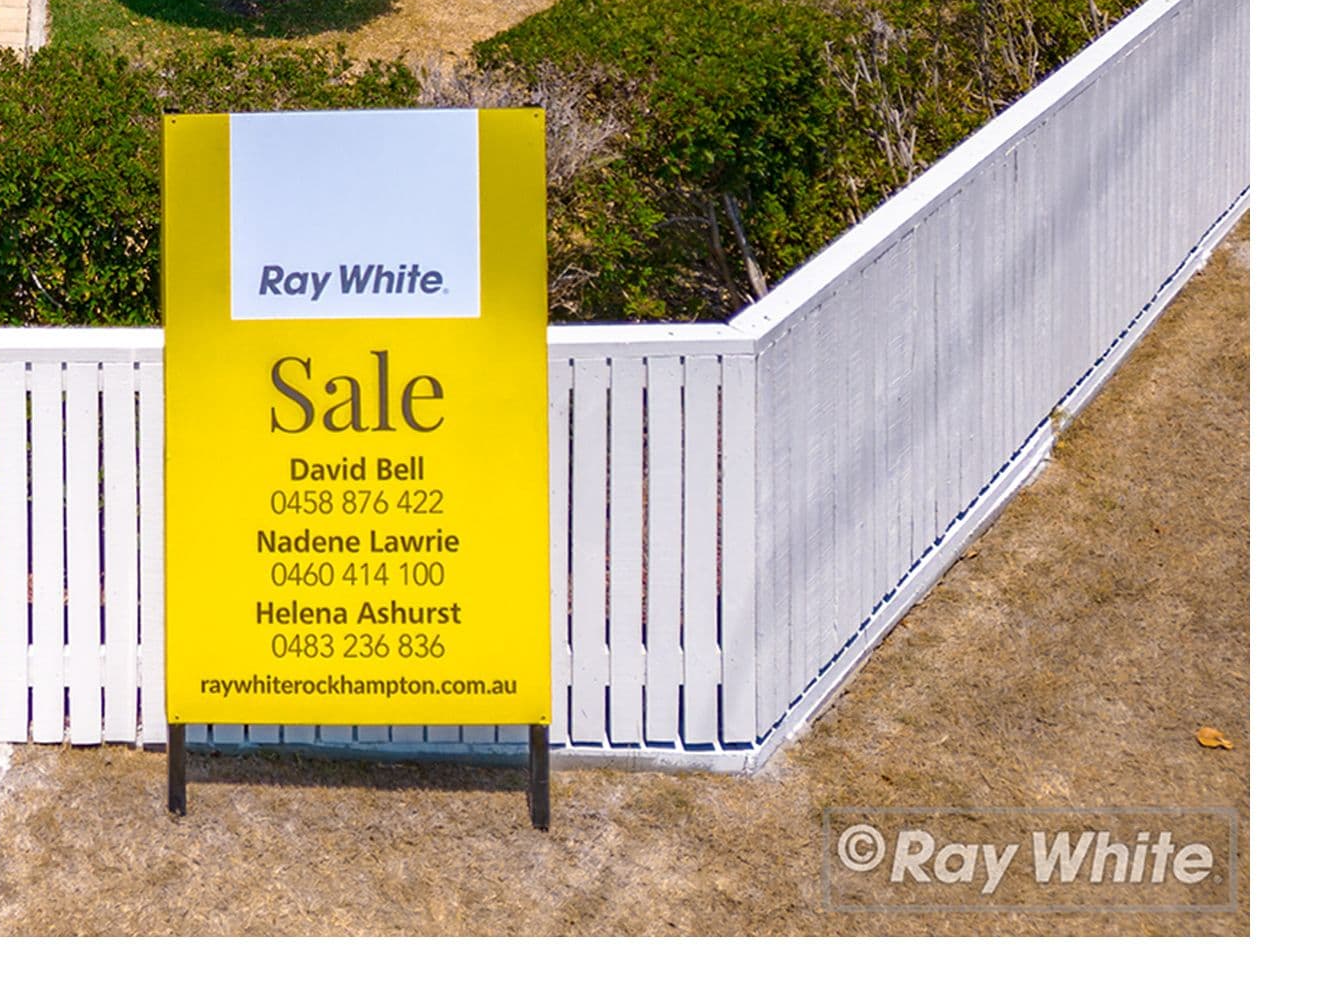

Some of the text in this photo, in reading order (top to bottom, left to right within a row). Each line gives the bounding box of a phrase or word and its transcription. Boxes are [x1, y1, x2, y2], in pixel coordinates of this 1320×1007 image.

[258, 263, 444, 301] Ray White
[270, 349, 445, 434] Sale
[290, 457, 424, 481] David Bell
[270, 490, 444, 515] 0458 876 422
[257, 529, 460, 553] Nadene Lawrie
[271, 562, 445, 586] 0460 414 100
[256, 600, 462, 625] Helena Ashurst
[271, 634, 445, 658] 0483 236 836
[200, 675, 518, 698] raywhiterockhampton.com.au
